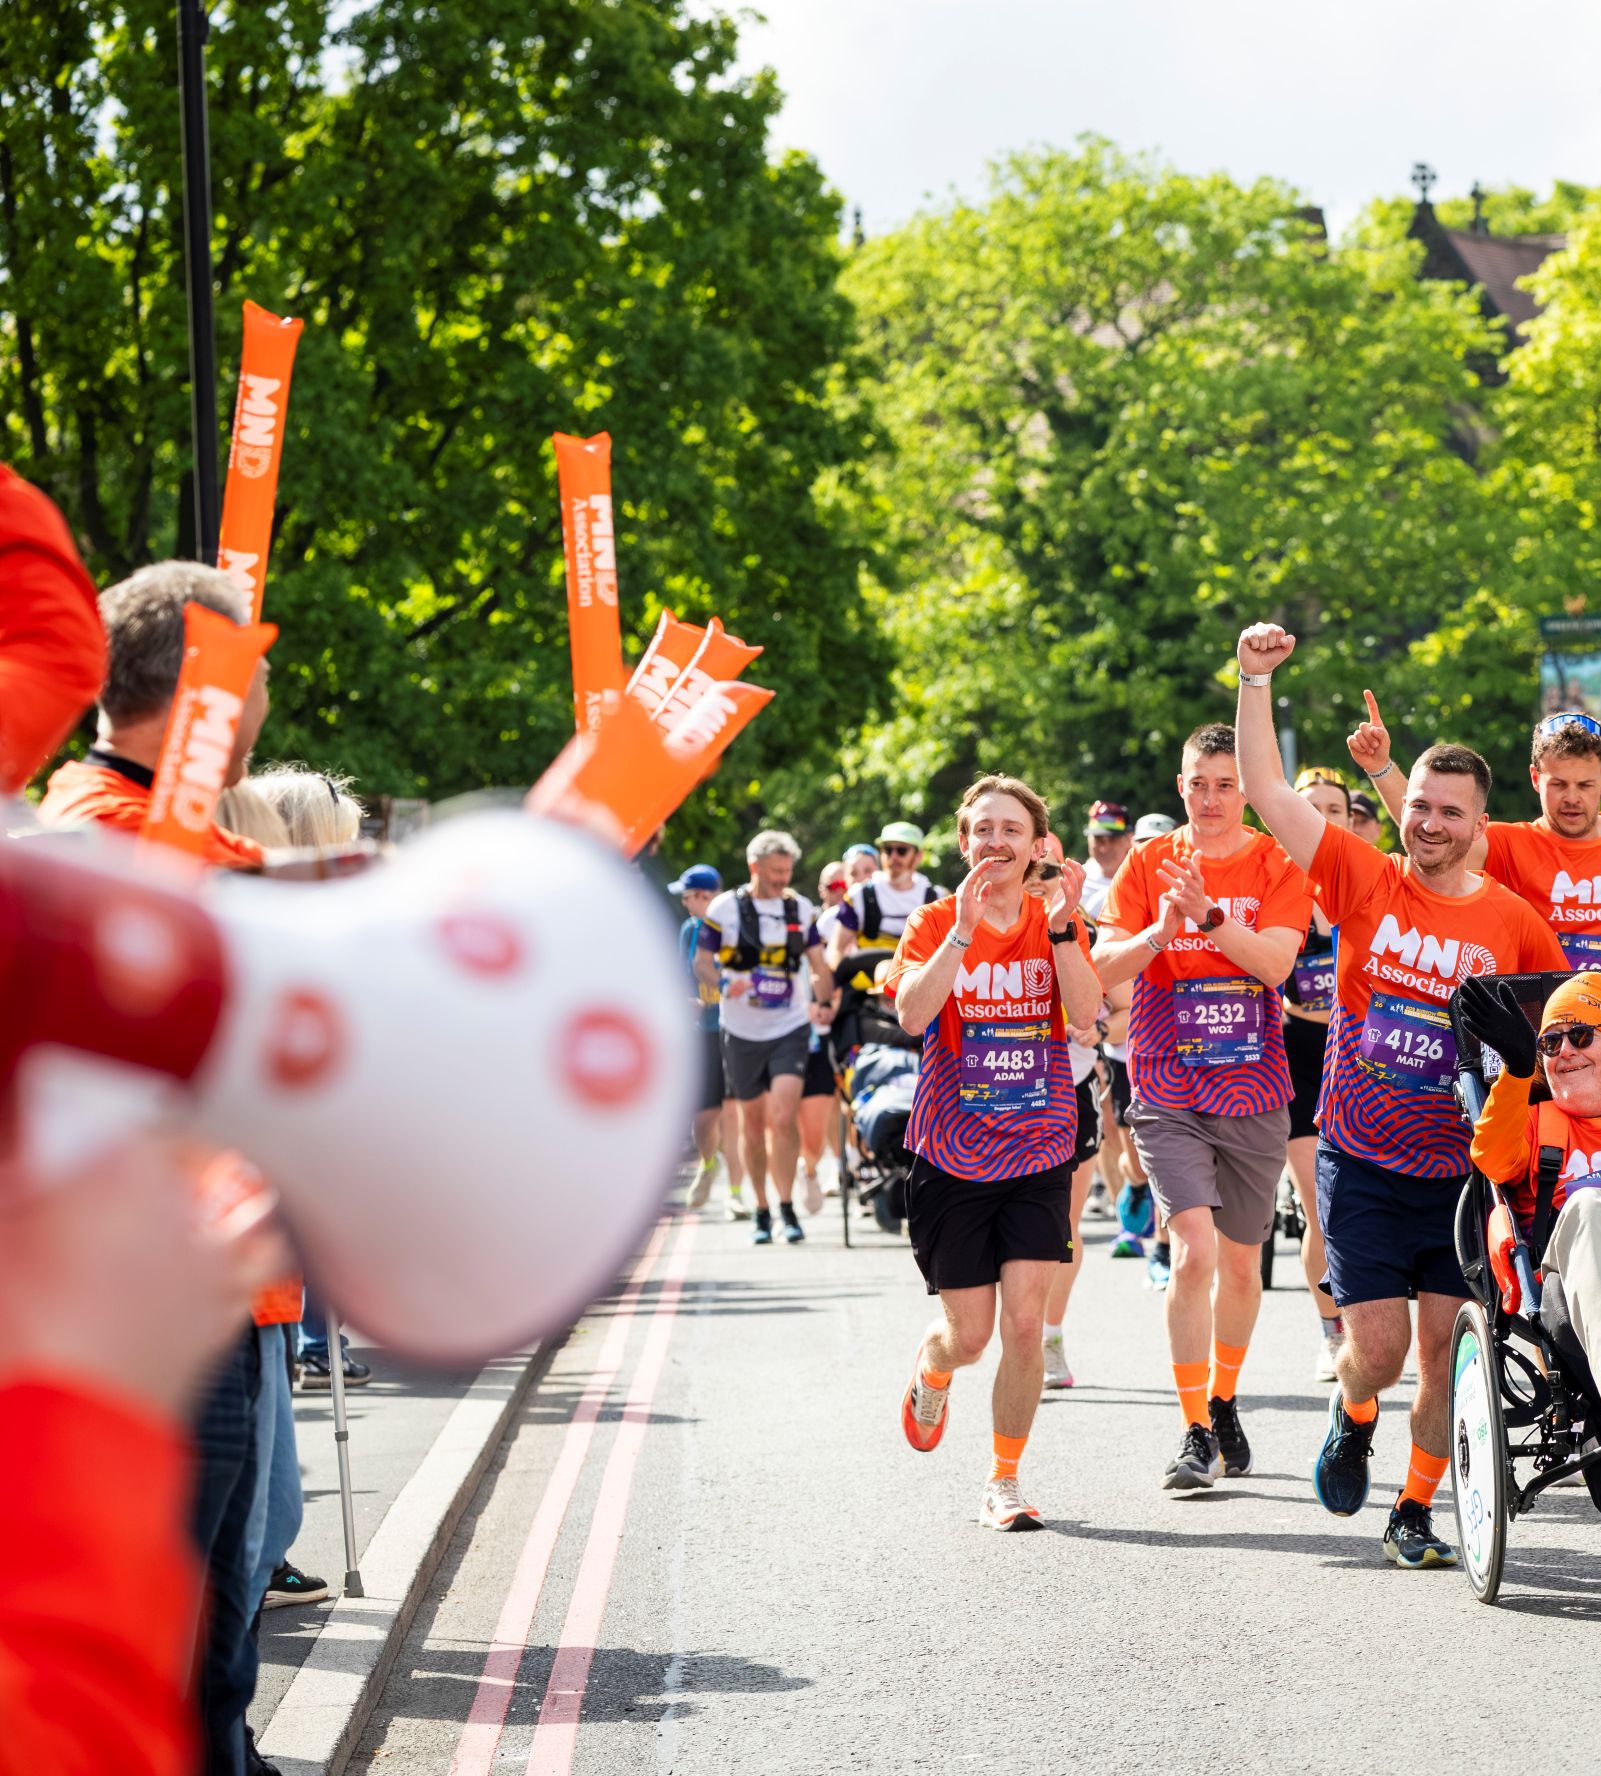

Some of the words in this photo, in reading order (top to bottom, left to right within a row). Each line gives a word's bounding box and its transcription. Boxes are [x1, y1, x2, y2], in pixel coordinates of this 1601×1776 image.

[236, 373, 282, 479] MND
[571, 496, 594, 608] Association
[589, 494, 618, 607] MND
[170, 683, 244, 833] MND
[1167, 937, 1221, 953] Assoc
[1369, 913, 1497, 985] MND
[953, 958, 1052, 1000] MND
[1194, 1003, 1246, 1024] 2532
[1208, 1025, 1234, 1035] WOZ
[1384, 1028, 1443, 1060] 4126
[983, 1050, 1035, 1070] 4483
[1395, 1055, 1426, 1069] MATT
[994, 1072, 1025, 1081] ADAM
[1031, 1099, 1046, 1108] 4483
